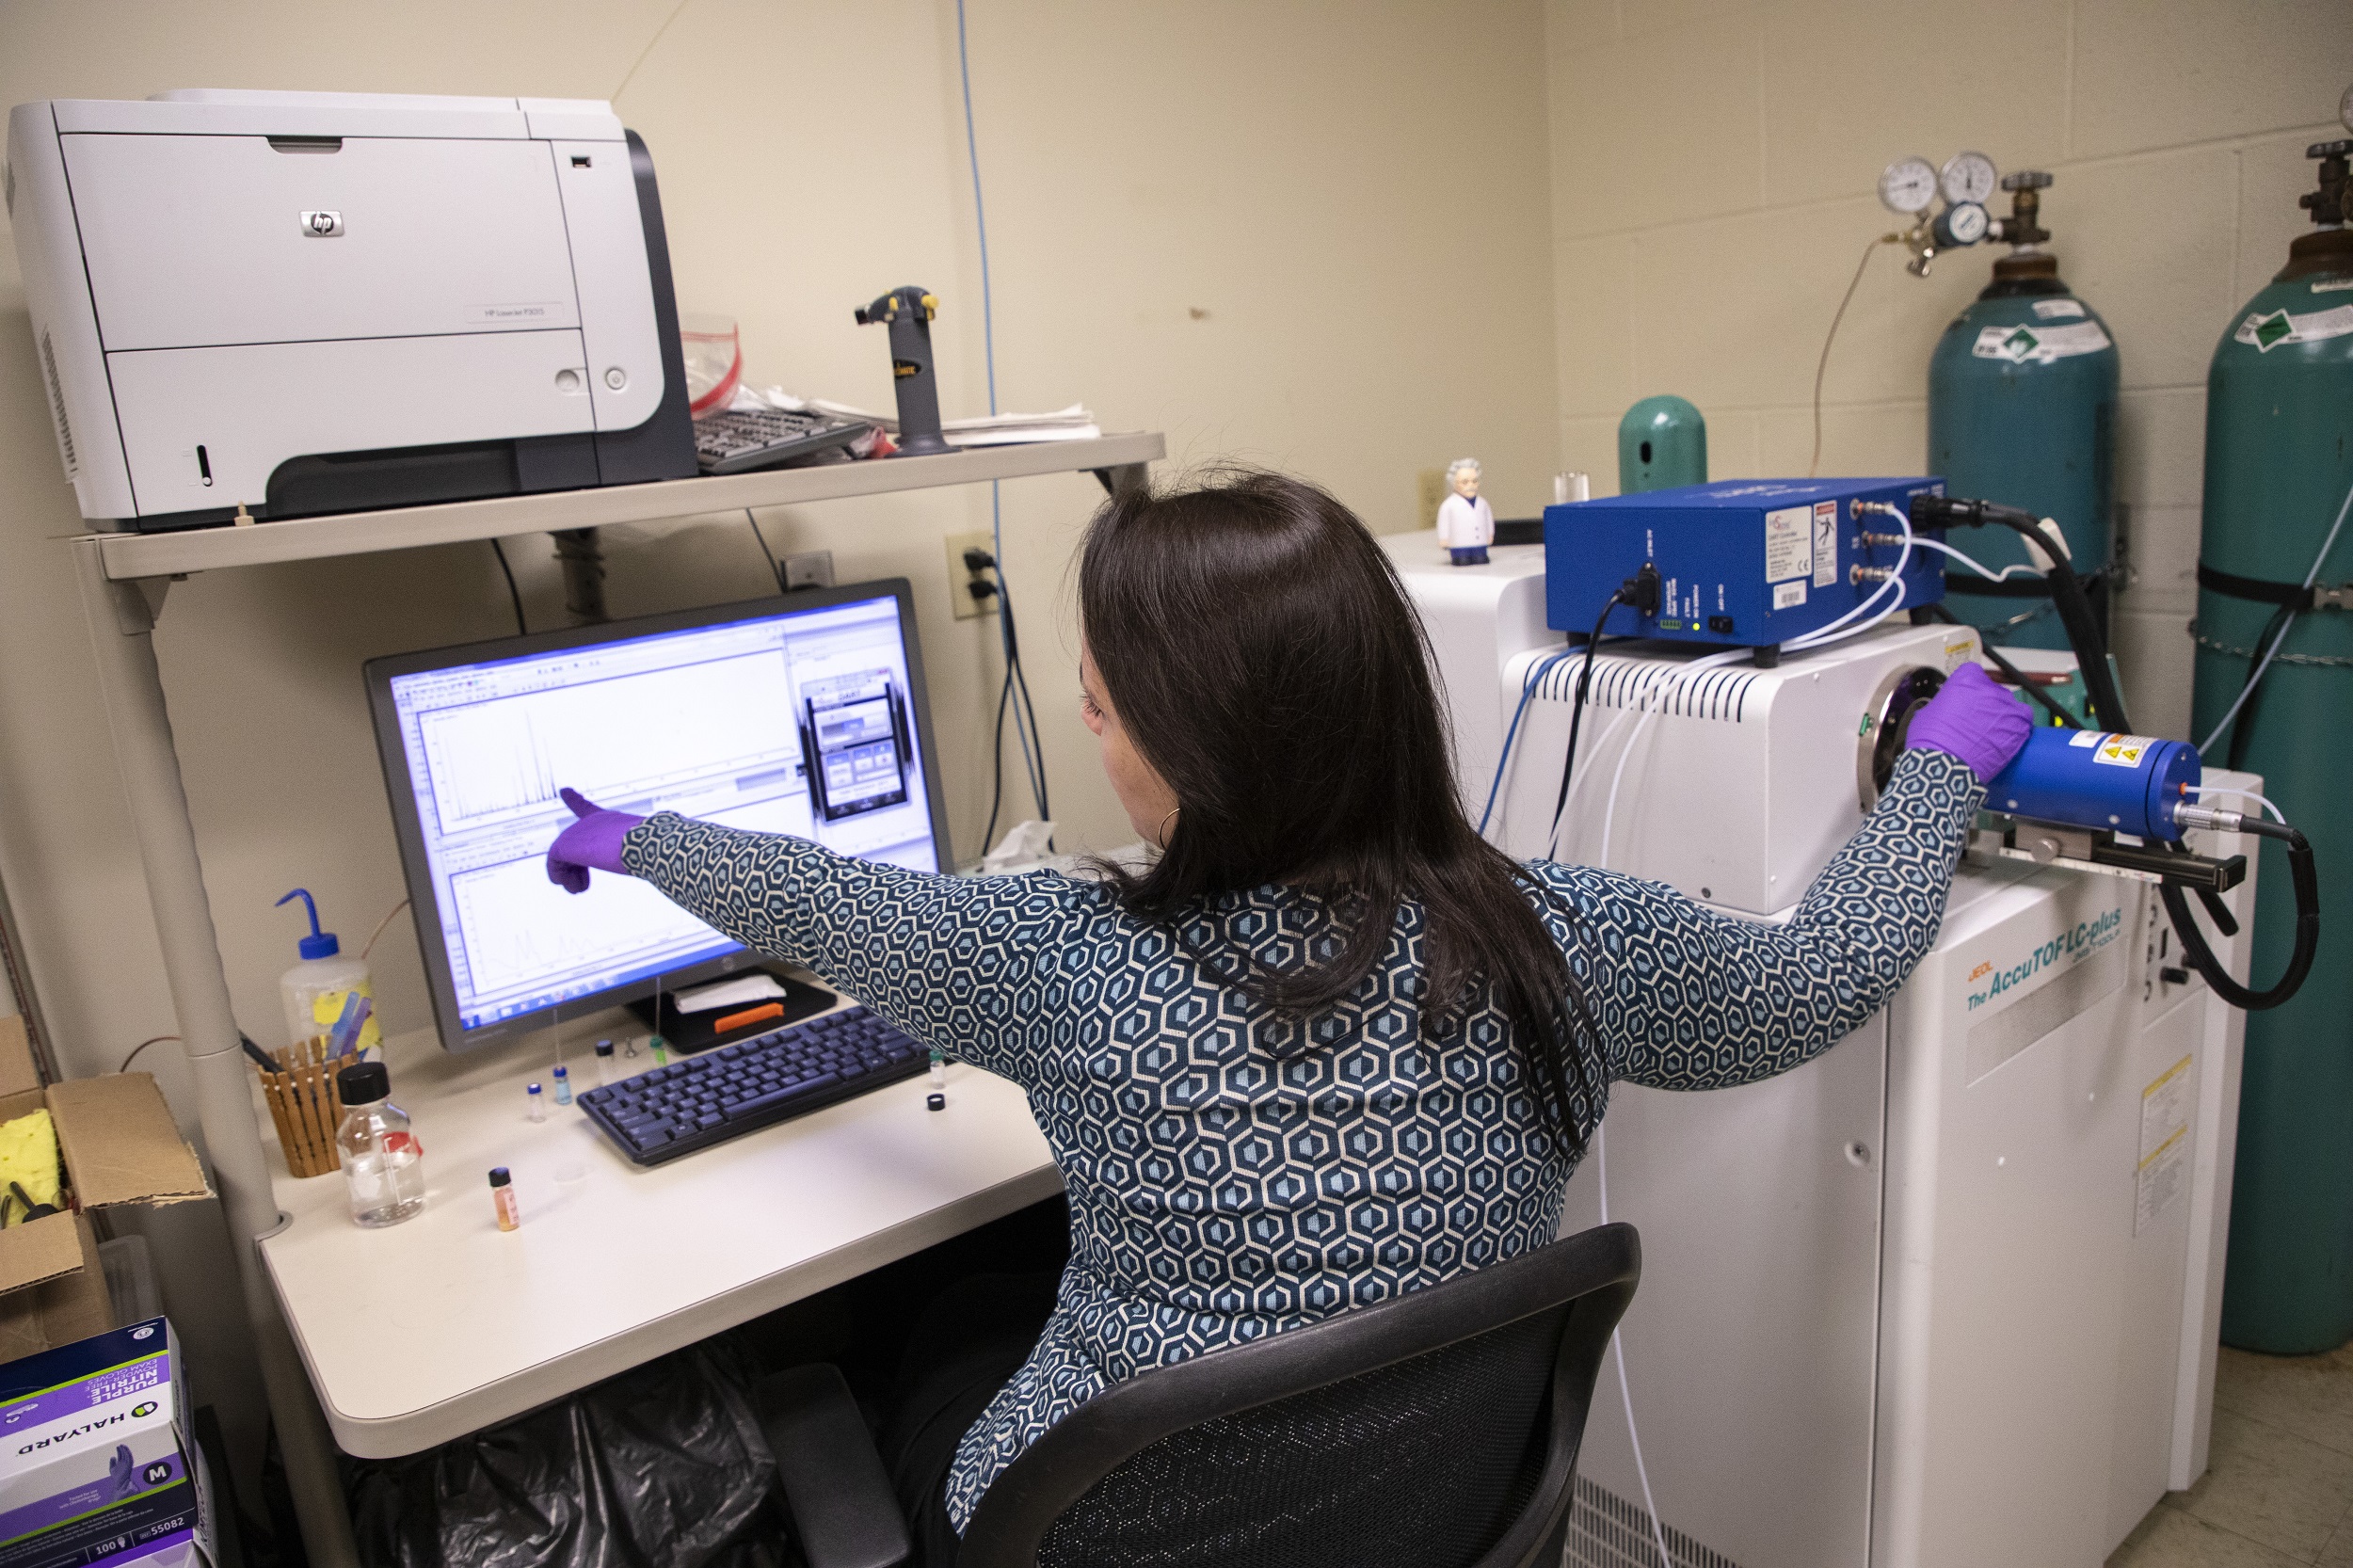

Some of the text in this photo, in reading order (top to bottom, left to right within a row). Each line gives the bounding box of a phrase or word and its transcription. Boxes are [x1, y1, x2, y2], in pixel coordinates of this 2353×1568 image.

[313, 211, 332, 235] hp
[1967, 907, 2121, 1011] The AccuTOF LC-plus
[1967, 959, 1994, 983] JEOL
[85, 1363, 158, 1391] POWDER-FREE
[88, 1358, 157, 1384] EXAM GLOVES
[90, 1368, 158, 1398] NITRILE
[91, 1376, 158, 1405] PURPLE
[18, 1412, 125, 1456] HALYARD
[149, 1465, 168, 1482] M
[151, 1516, 185, 1536] 55082
[96, 1540, 117, 1555] 100
